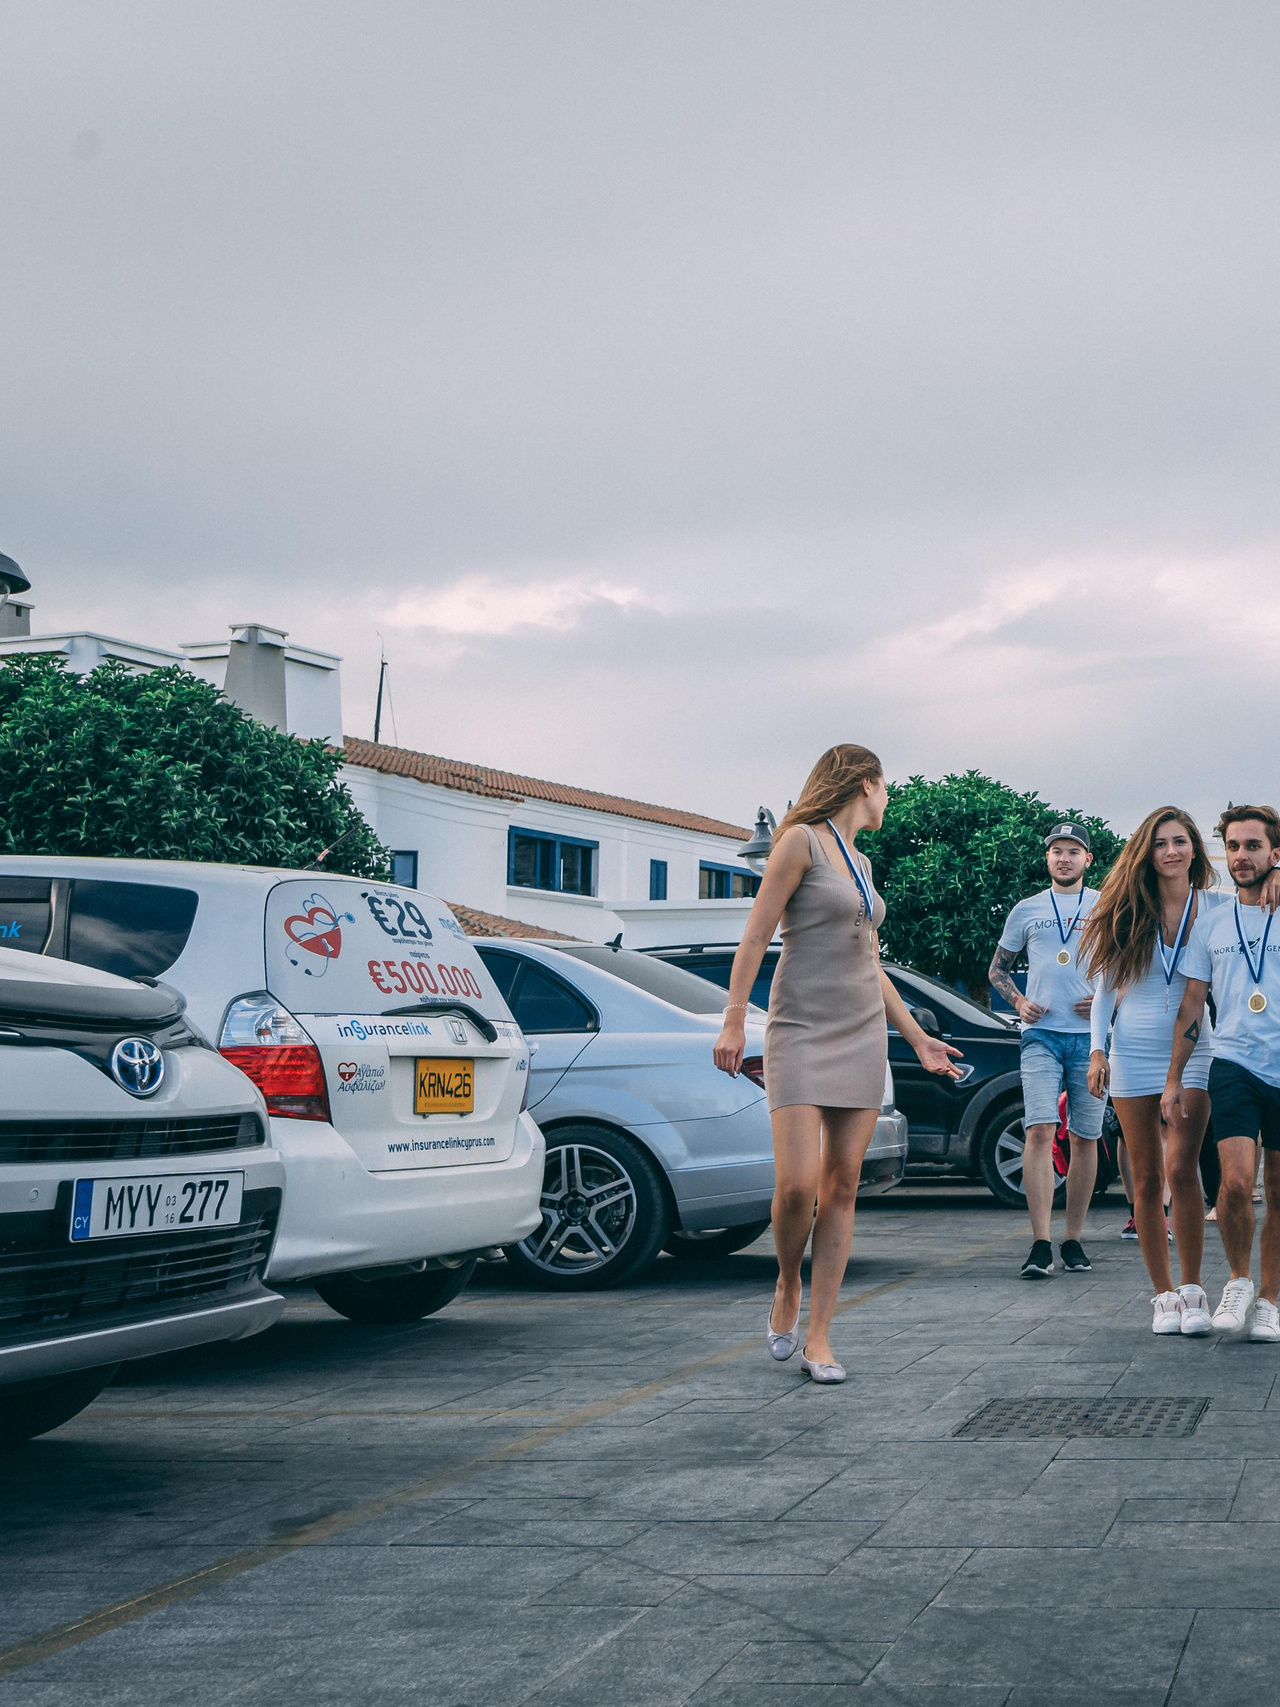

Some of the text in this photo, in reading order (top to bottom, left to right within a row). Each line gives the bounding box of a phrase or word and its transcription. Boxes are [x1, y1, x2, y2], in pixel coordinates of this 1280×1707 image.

[367, 896, 433, 939] €29
[1214, 945, 1235, 955] MORE
[367, 960, 482, 999] €500.000
[419, 1072, 472, 1098] KRN426
[388, 1136, 495, 1153] www.insurancelinkcyprus.com
[105, 1179, 229, 1230] MYY 03 277
[74, 1216, 89, 1229] CY
[165, 1213, 175, 1224] 16
